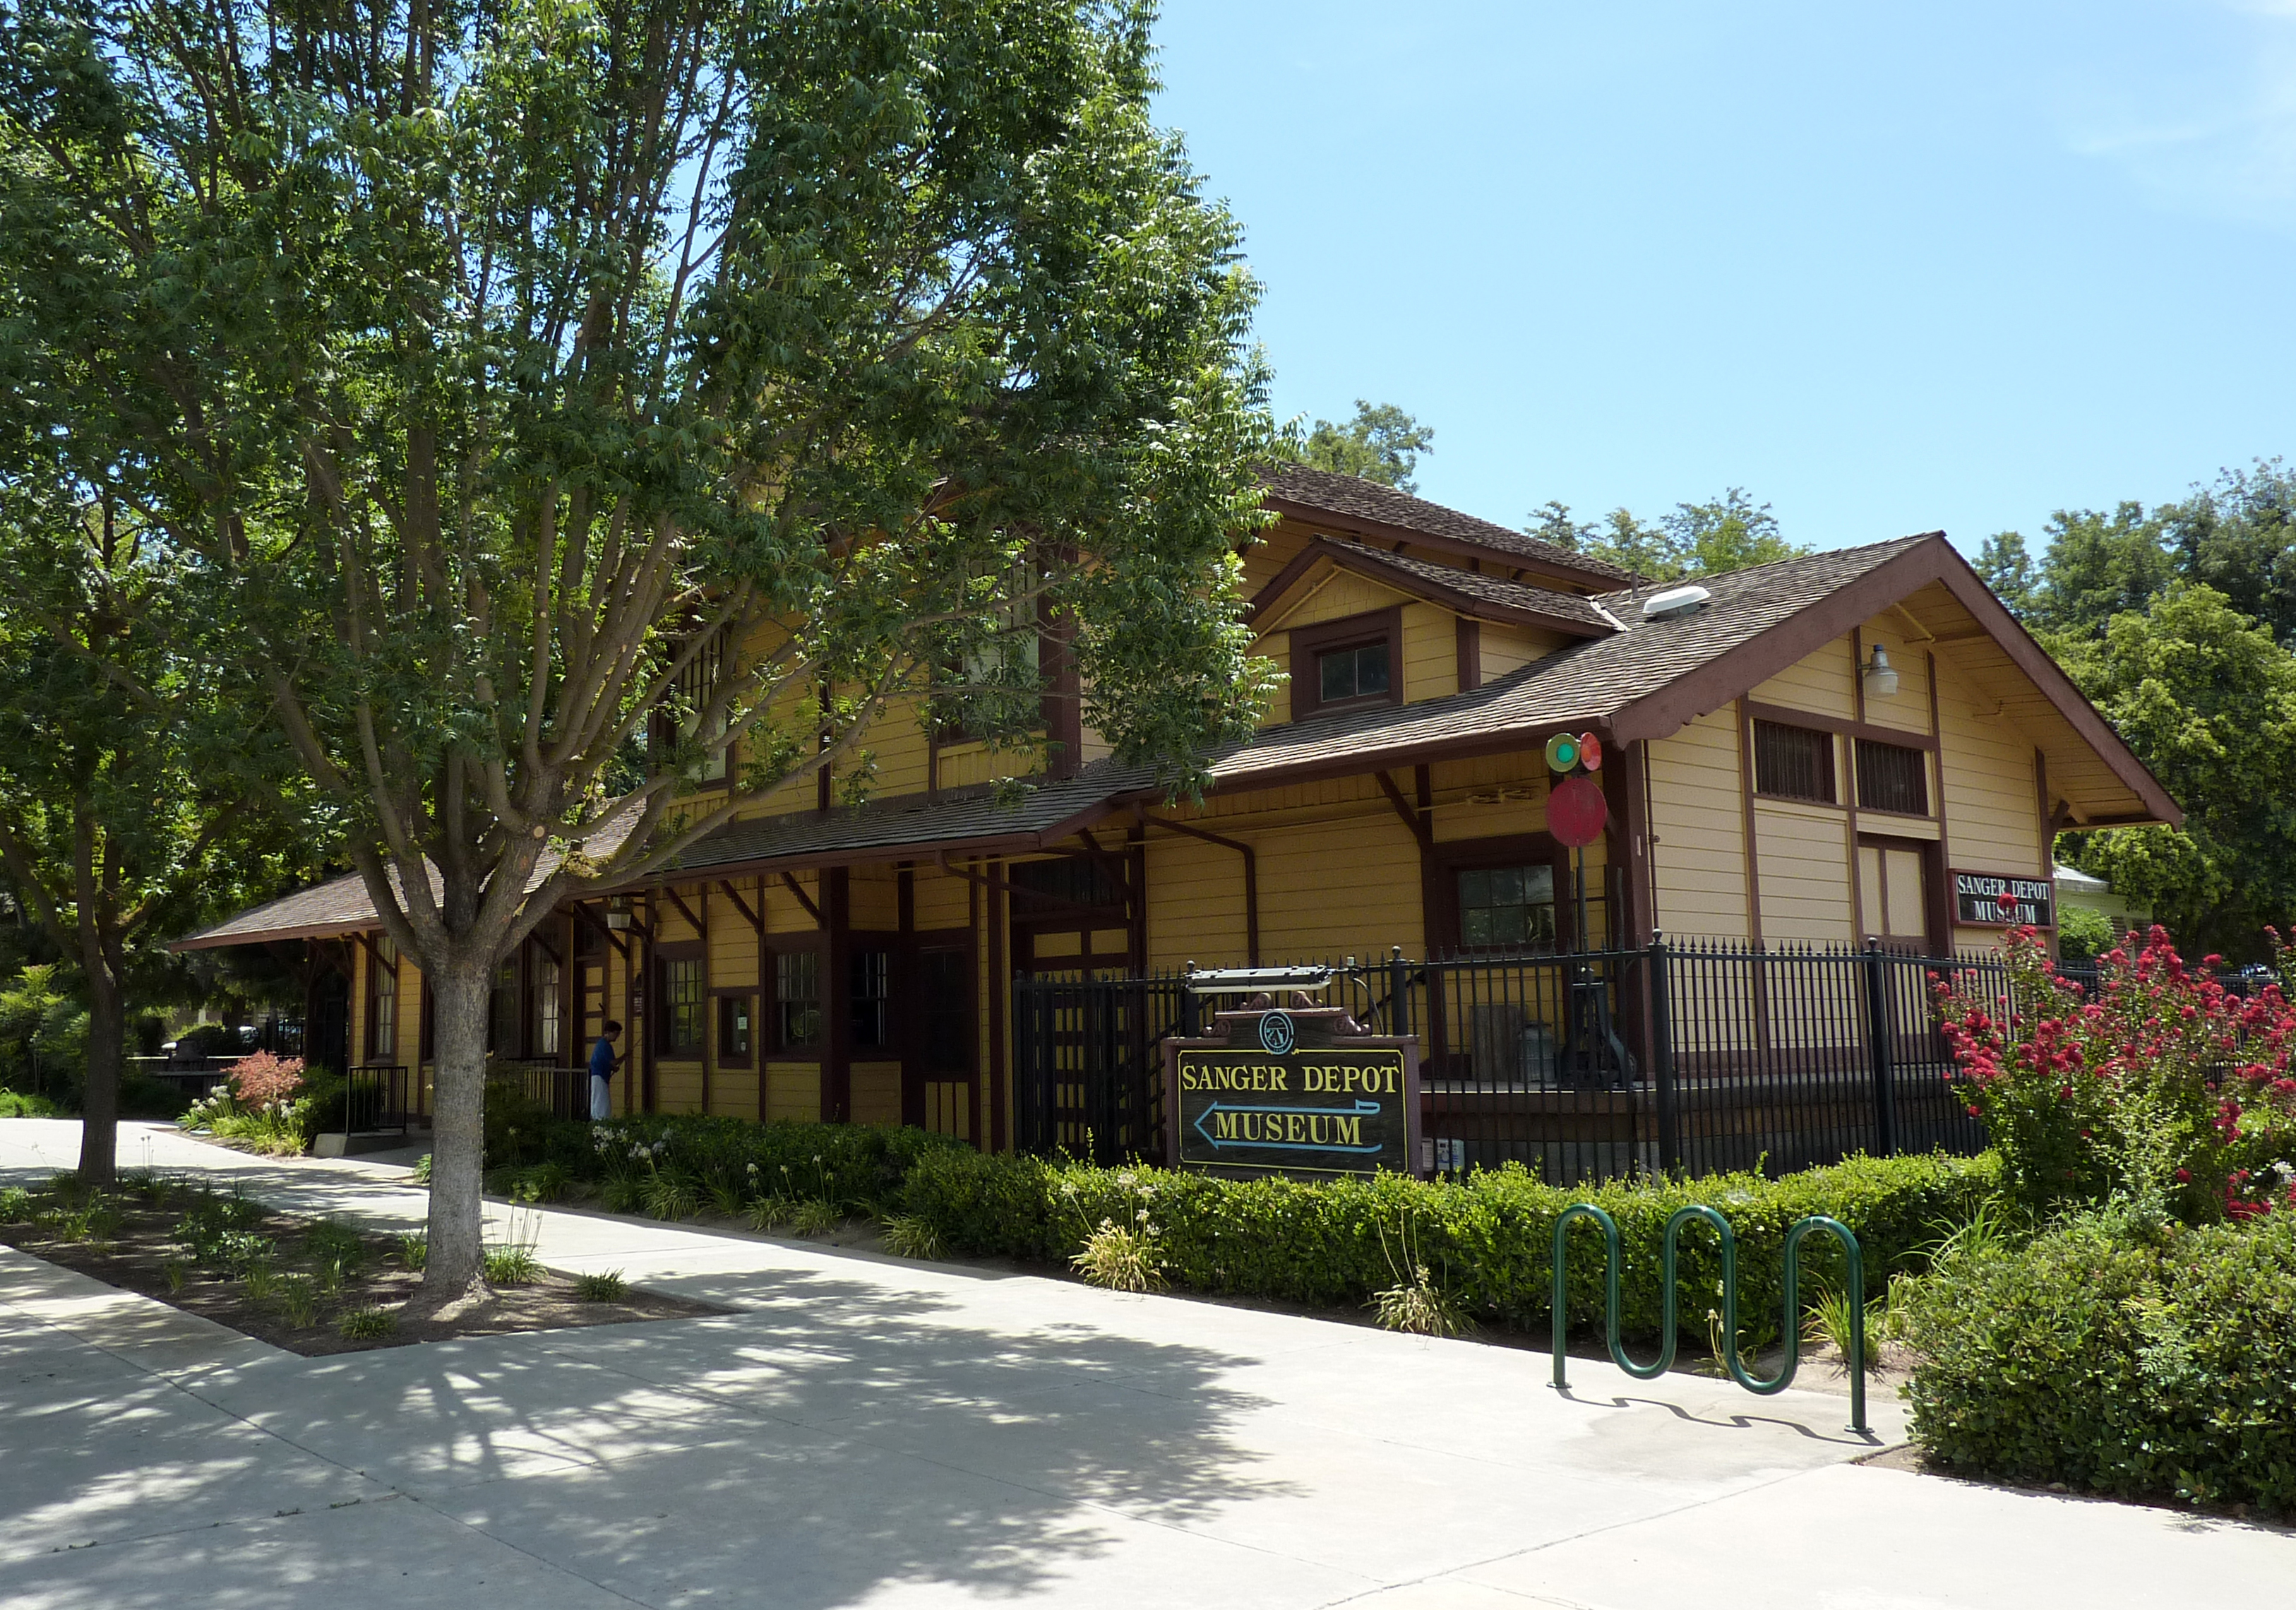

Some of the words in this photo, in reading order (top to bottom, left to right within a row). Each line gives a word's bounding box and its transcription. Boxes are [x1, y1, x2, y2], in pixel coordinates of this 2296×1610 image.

[1957, 875, 2006, 896] SANGER
[2011, 880, 2048, 900] DEPOT
[1974, 901, 2037, 924] MUSUM
[1181, 1064, 1289, 1092] SANGER
[1303, 1065, 1399, 1094] DEPOT
[1214, 1111, 1363, 1145] MUSEUM
